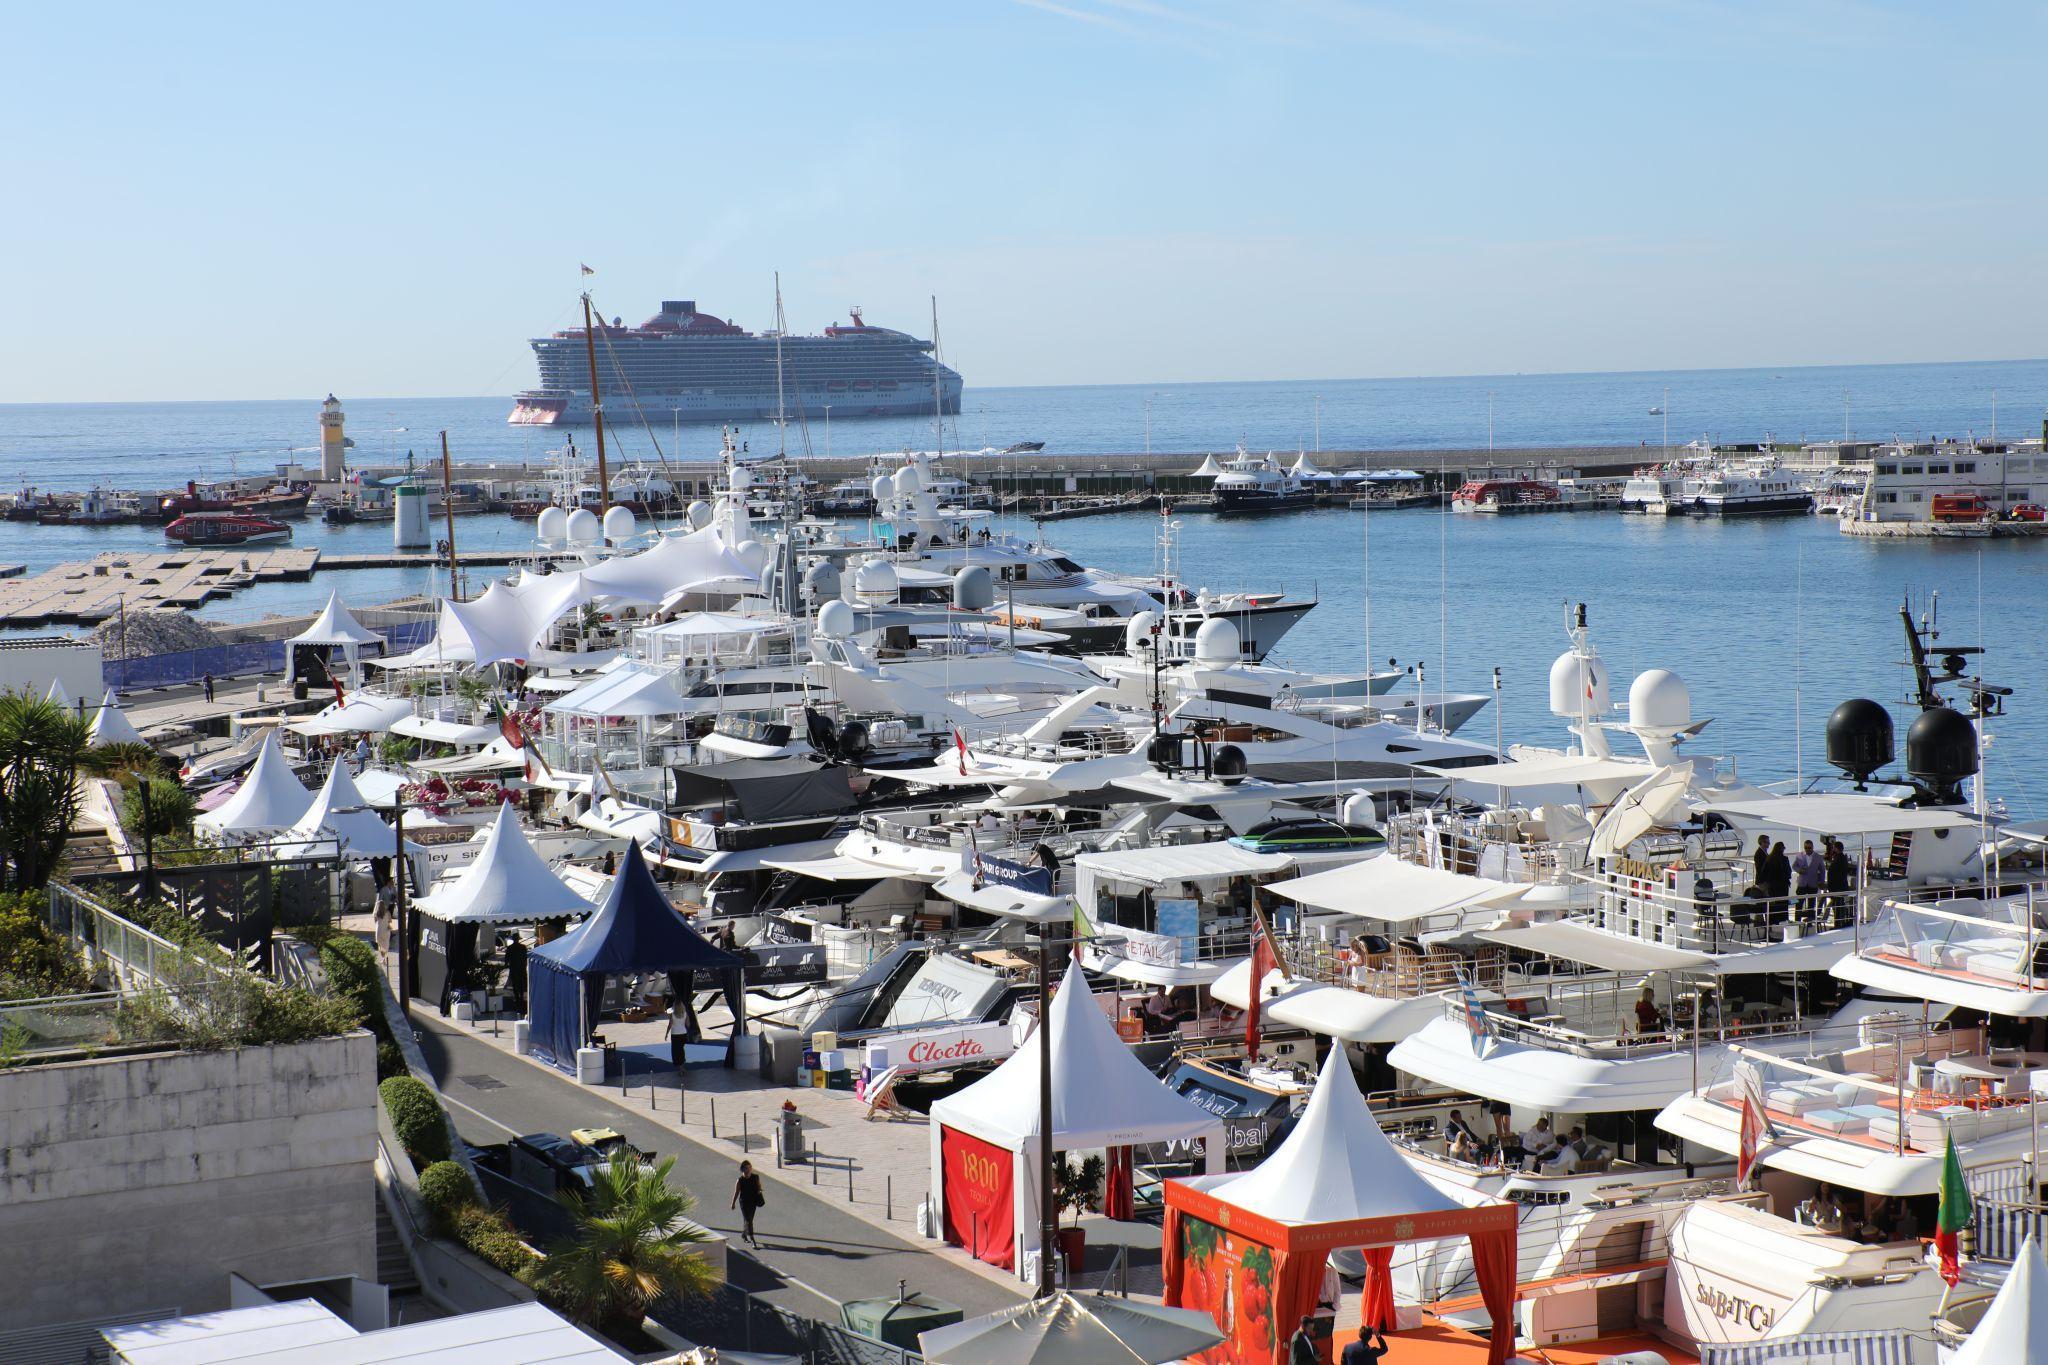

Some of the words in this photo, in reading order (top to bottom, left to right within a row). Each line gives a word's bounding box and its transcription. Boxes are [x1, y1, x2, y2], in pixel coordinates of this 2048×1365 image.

[418, 831, 473, 844] XERJOFF
[972, 858, 995, 875] CPARI
[995, 866, 1018, 880] GROUP
[763, 967, 783, 975] JAVA
[797, 964, 817, 972] JAVA
[908, 1038, 984, 1064] Cloetta
[961, 1149, 999, 1192] 1800
[1425, 1220, 1457, 1228] SPIRIT
[1299, 1233, 1332, 1241] SPIRIT
